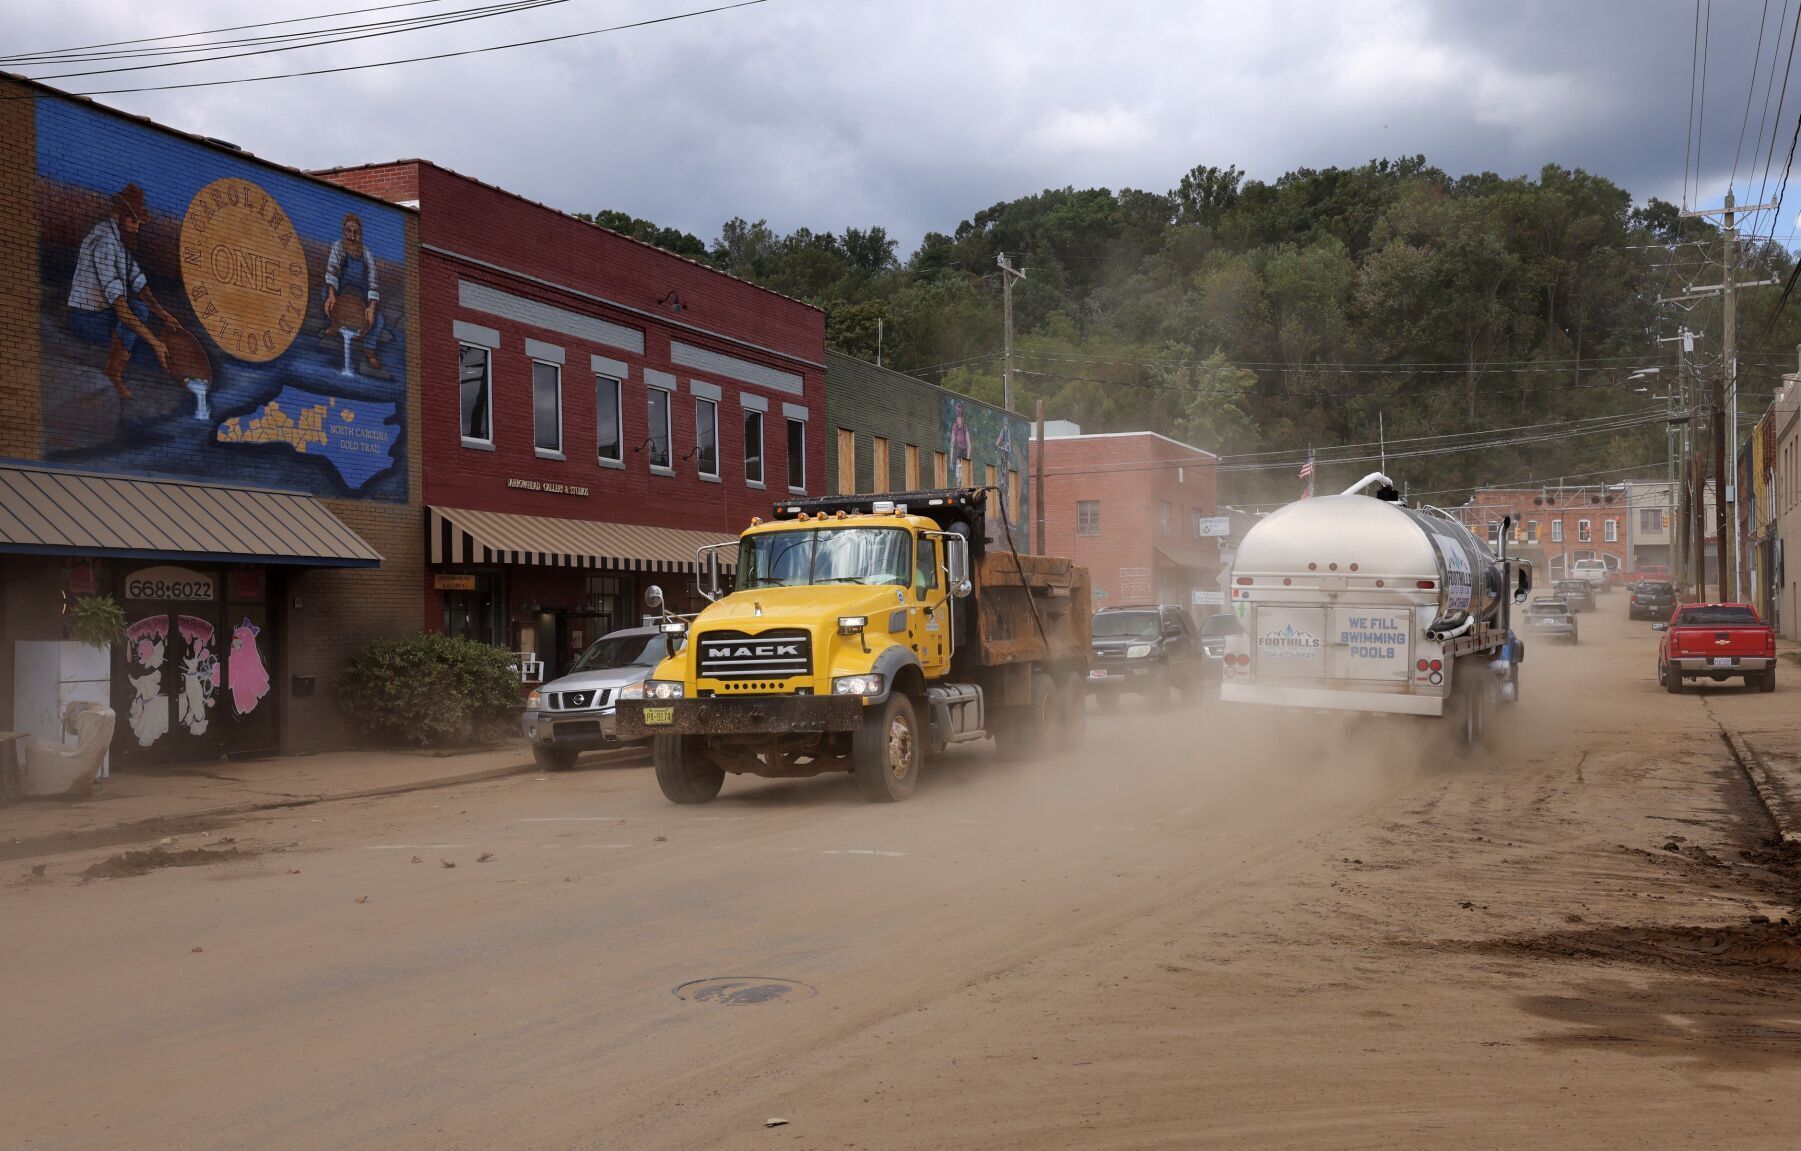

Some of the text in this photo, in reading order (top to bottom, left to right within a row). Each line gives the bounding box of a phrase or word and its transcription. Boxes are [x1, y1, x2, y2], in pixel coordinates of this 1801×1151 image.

[190, 184, 293, 249] CAROLINA
[210, 244, 282, 297] ONE
[191, 280, 276, 355] DOLLAR
[330, 424, 389, 442] NORTH CAROLINA
[340, 440, 359, 451] GOLD
[508, 478, 541, 491] ARROWHEAD
[542, 482, 564, 493] GALLERY
[569, 486, 589, 496] STUDIOS
[1447, 570, 1472, 588] FOOTHILLS
[1348, 617, 1398, 630] WE FILL
[1258, 637, 1320, 648] FOOTHILLS
[1341, 631, 1406, 645] SWIMMING
[708, 645, 799, 658] MACK
[1350, 646, 1395, 659] POOLS
